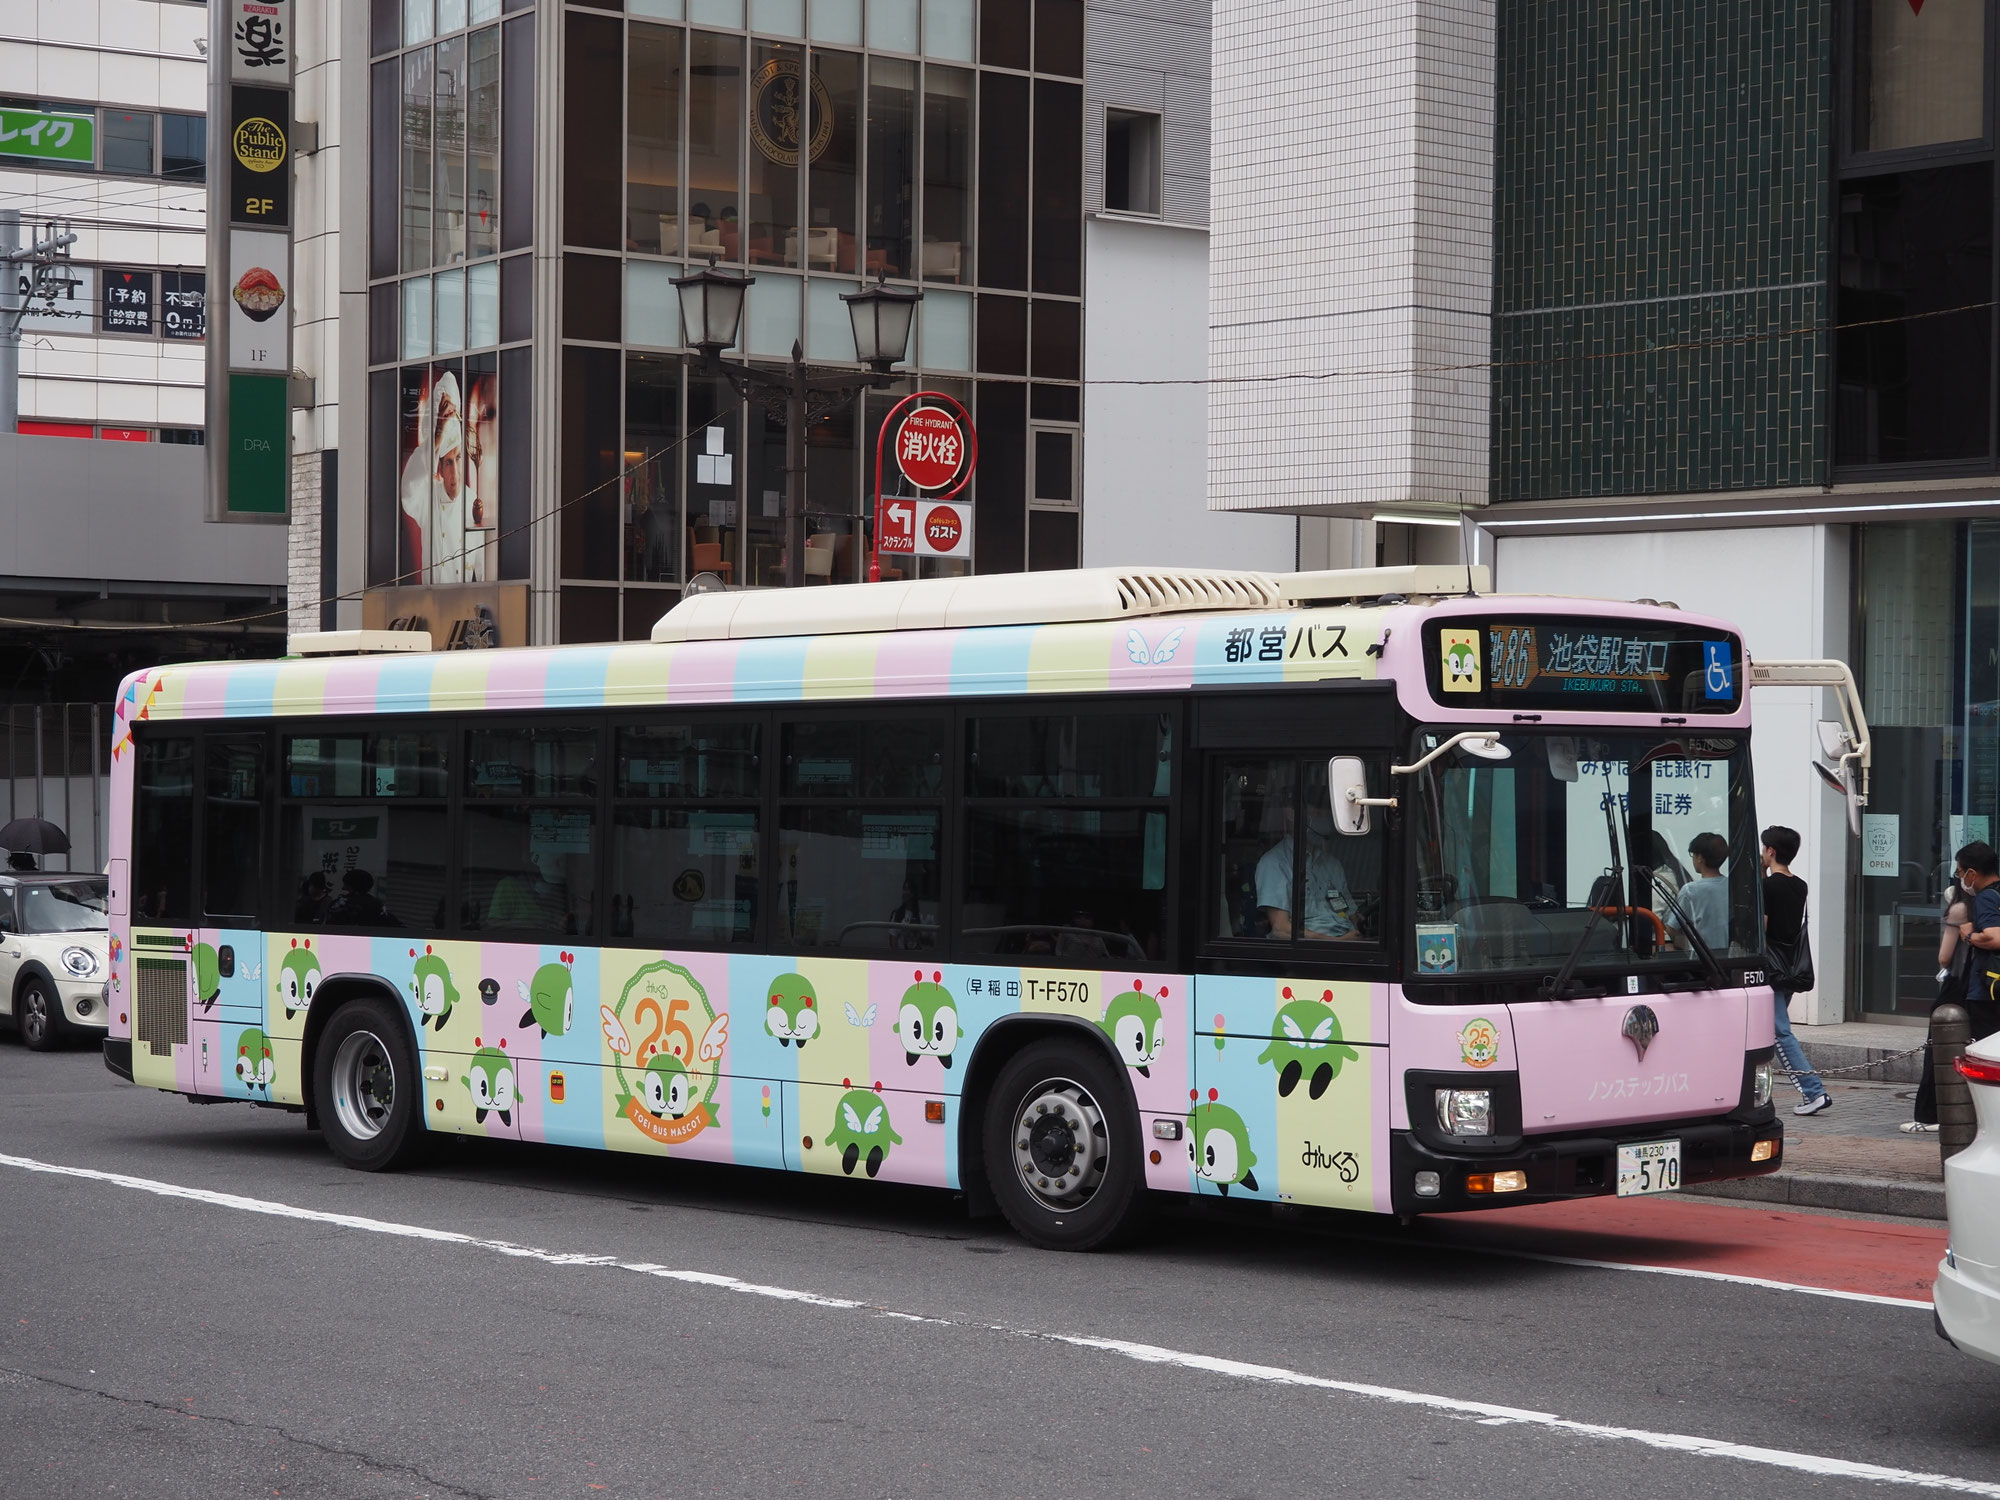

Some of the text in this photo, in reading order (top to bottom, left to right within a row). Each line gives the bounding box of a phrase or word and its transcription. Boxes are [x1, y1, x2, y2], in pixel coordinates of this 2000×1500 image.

[235, 15, 286, 67] 楽
[753, 66, 775, 89] LINDT
[0, 115, 74, 148] レイク
[248, 121, 271, 133] The
[240, 129, 282, 147] Public
[240, 144, 280, 160] Stand
[246, 197, 273, 214] 2F
[909, 416, 954, 430] FIRE HYDRANT
[244, 438, 271, 451] DRA
[902, 430, 958, 466] 消火栓
[929, 525, 958, 539] ガスト
[883, 535, 914, 549] スクランブル
[1225, 623, 1349, 663] 都営バス
[1545, 632, 1669, 676] 池袋駅東口
[1562, 678, 1644, 693] IKEBUKURO STA.
[1869, 860, 1894, 869] OPEN!
[1743, 970, 1765, 985] F570
[1027, 979, 1089, 1003] T-F570
[634, 997, 695, 1068] 25
[1469, 1028, 1491, 1049] 25
[1588, 1073, 1689, 1102] ノンステップバス
[633, 1108, 702, 1137] TOEI BUS MASCOT
